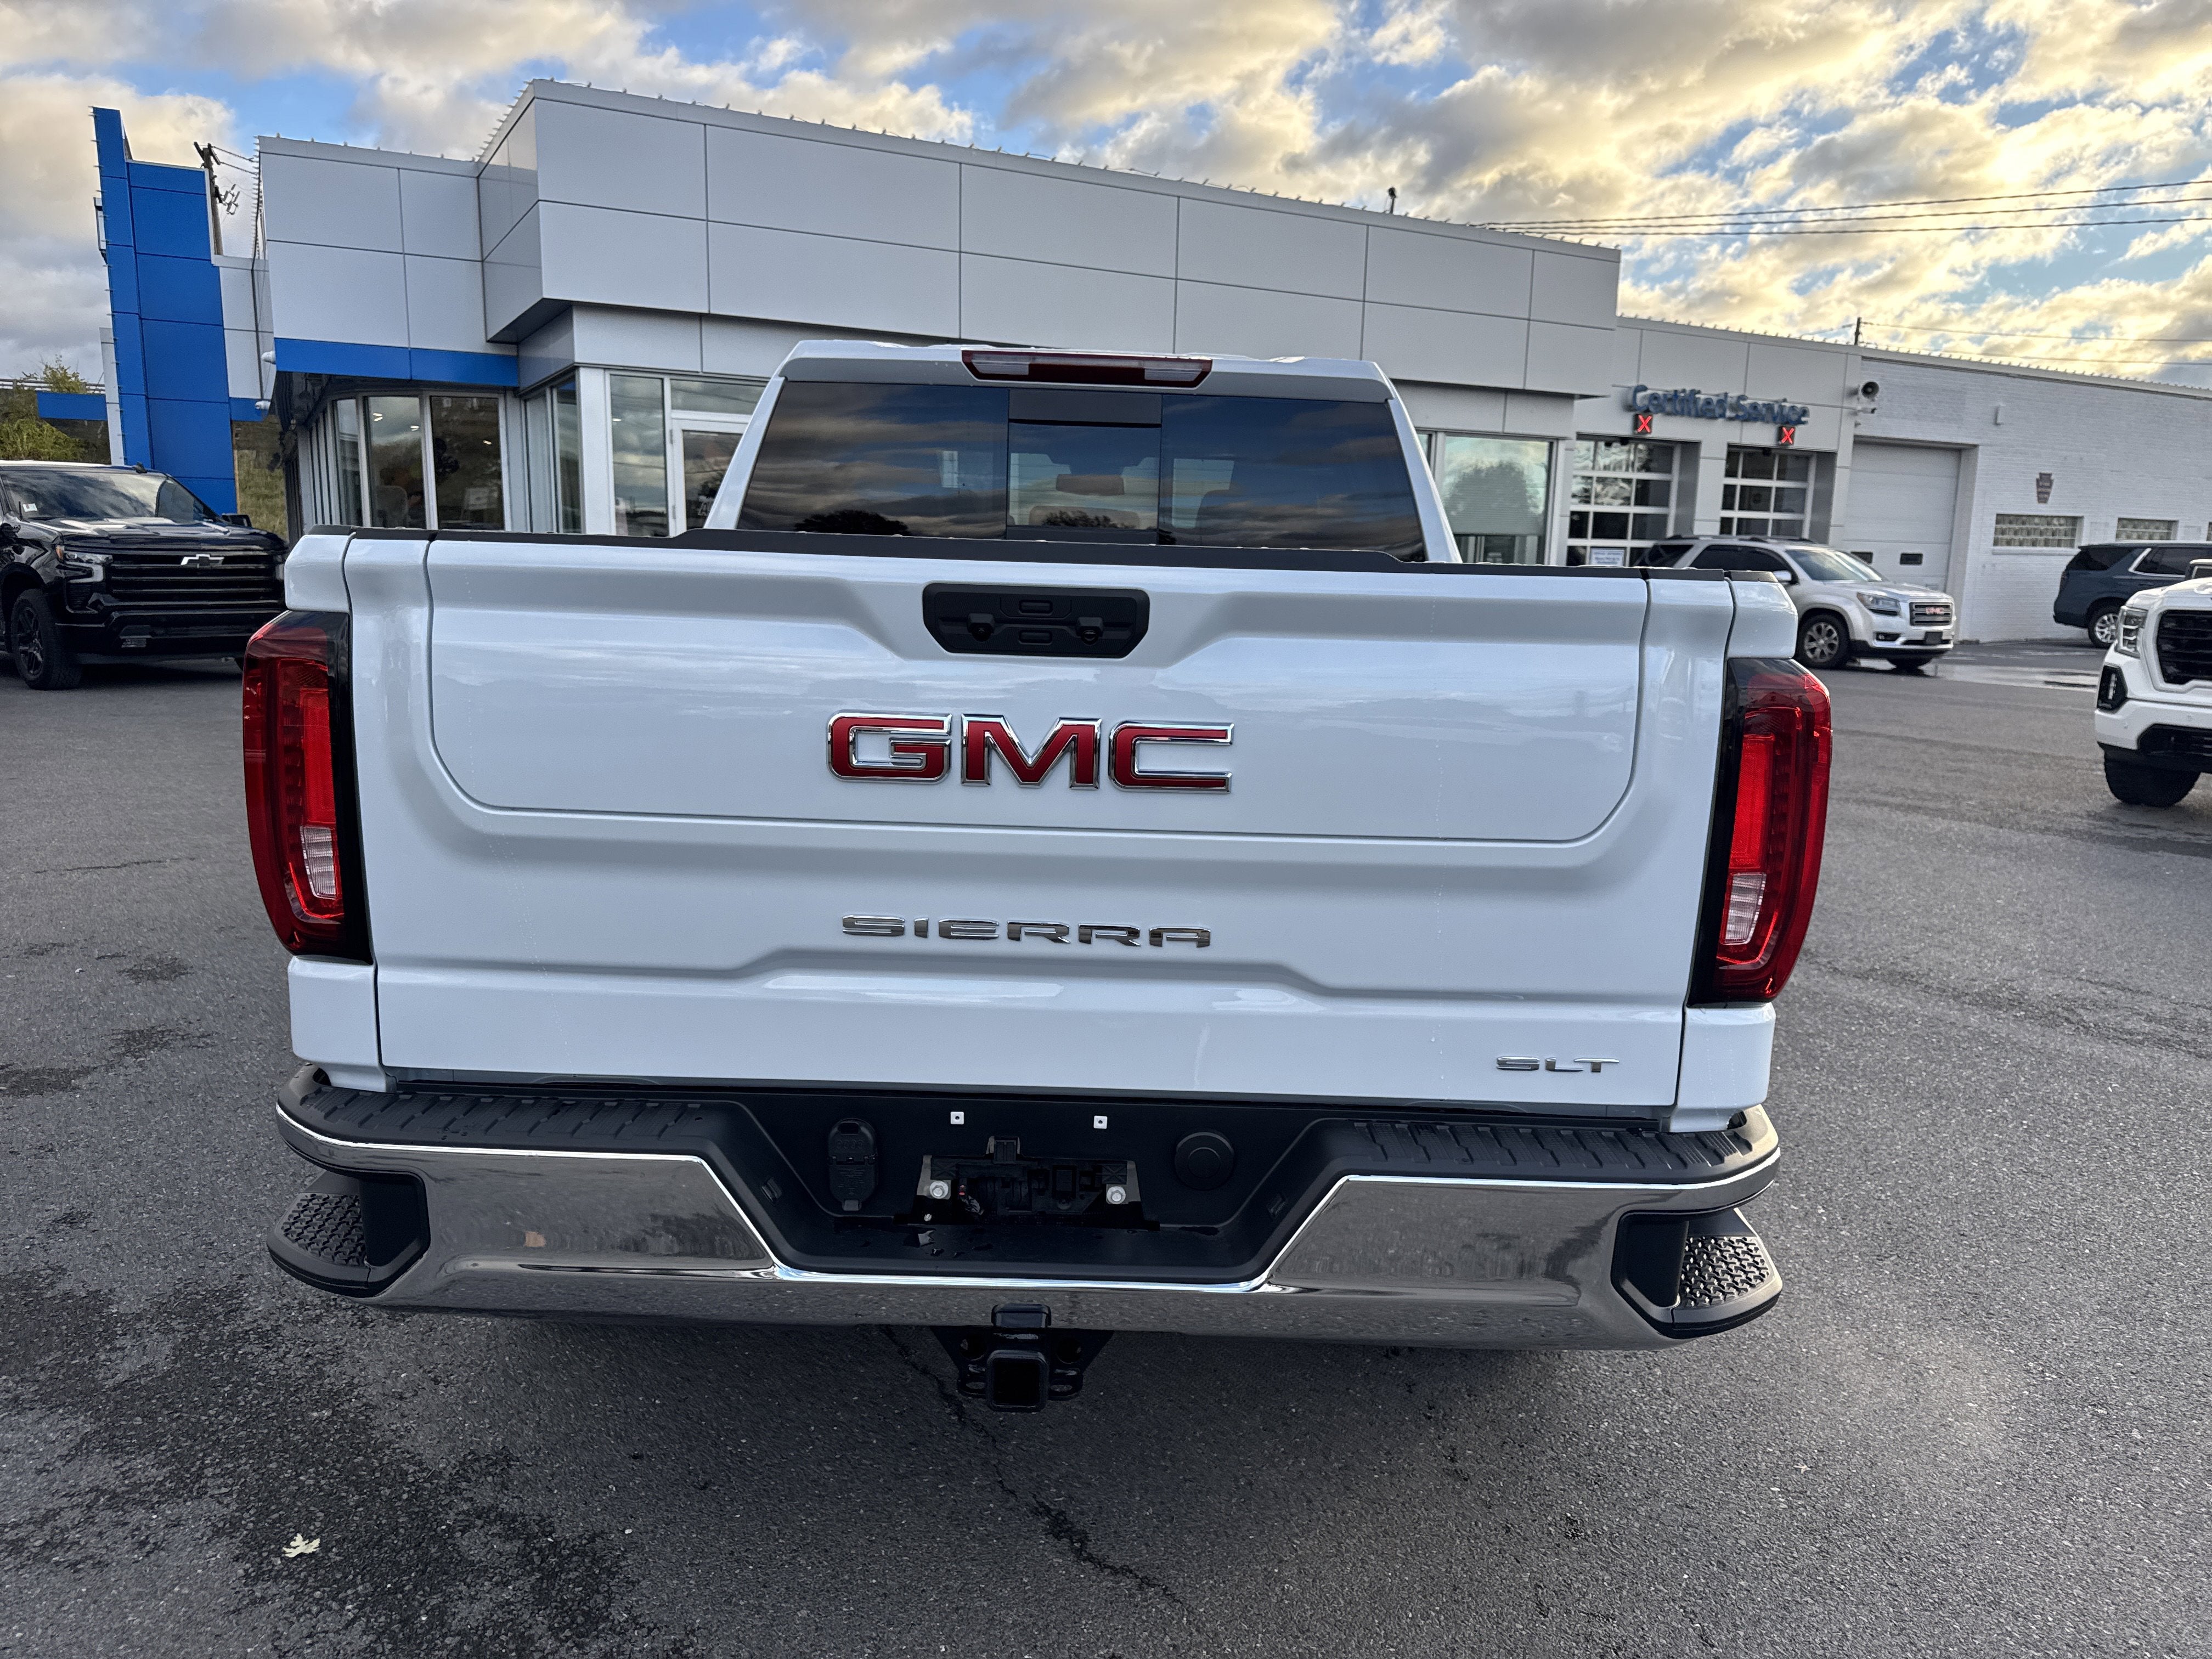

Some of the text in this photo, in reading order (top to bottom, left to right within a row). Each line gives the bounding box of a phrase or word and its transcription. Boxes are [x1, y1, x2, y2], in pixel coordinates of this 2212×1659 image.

[1633, 385, 1810, 425] Certified Service
[827, 712, 1235, 794] GMC
[842, 914, 1211, 948] SIERRA
[1497, 1056, 1620, 1073] SLT
